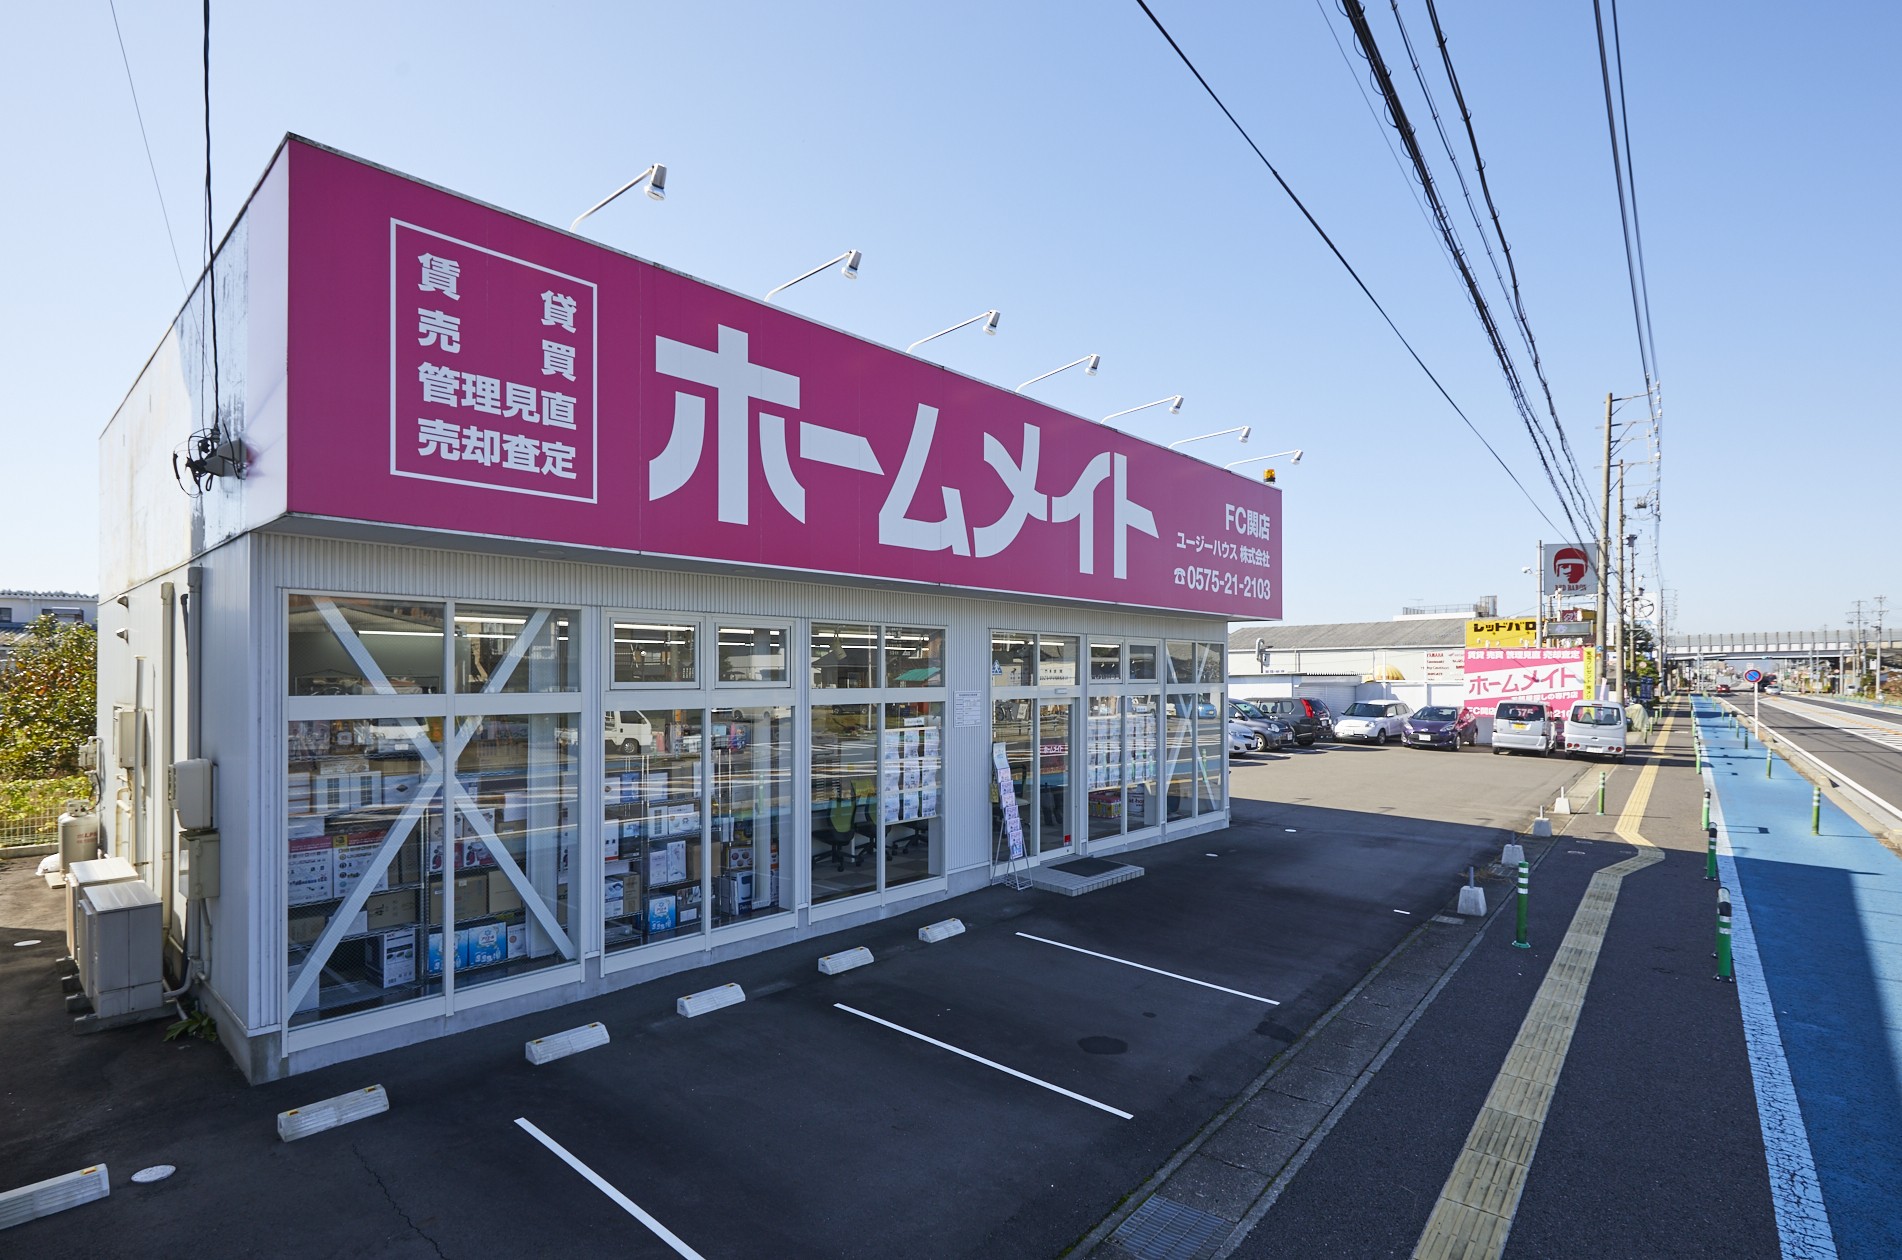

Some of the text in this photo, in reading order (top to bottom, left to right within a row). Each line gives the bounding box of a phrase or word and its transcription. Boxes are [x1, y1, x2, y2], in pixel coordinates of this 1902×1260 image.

[417, 361, 577, 431] 管理見直
[417, 417, 577, 481] 売却査定
[648, 323, 1160, 580] ホームメイト
[1225, 503, 1270, 541] FC関店
[1176, 532, 1270, 568] ユージーハウス 株式会社
[1187, 565, 1271, 600] 0575-21-2103
[1473, 621, 1537, 632] レッドバロ
[1468, 667, 1577, 695] ホームメイト
